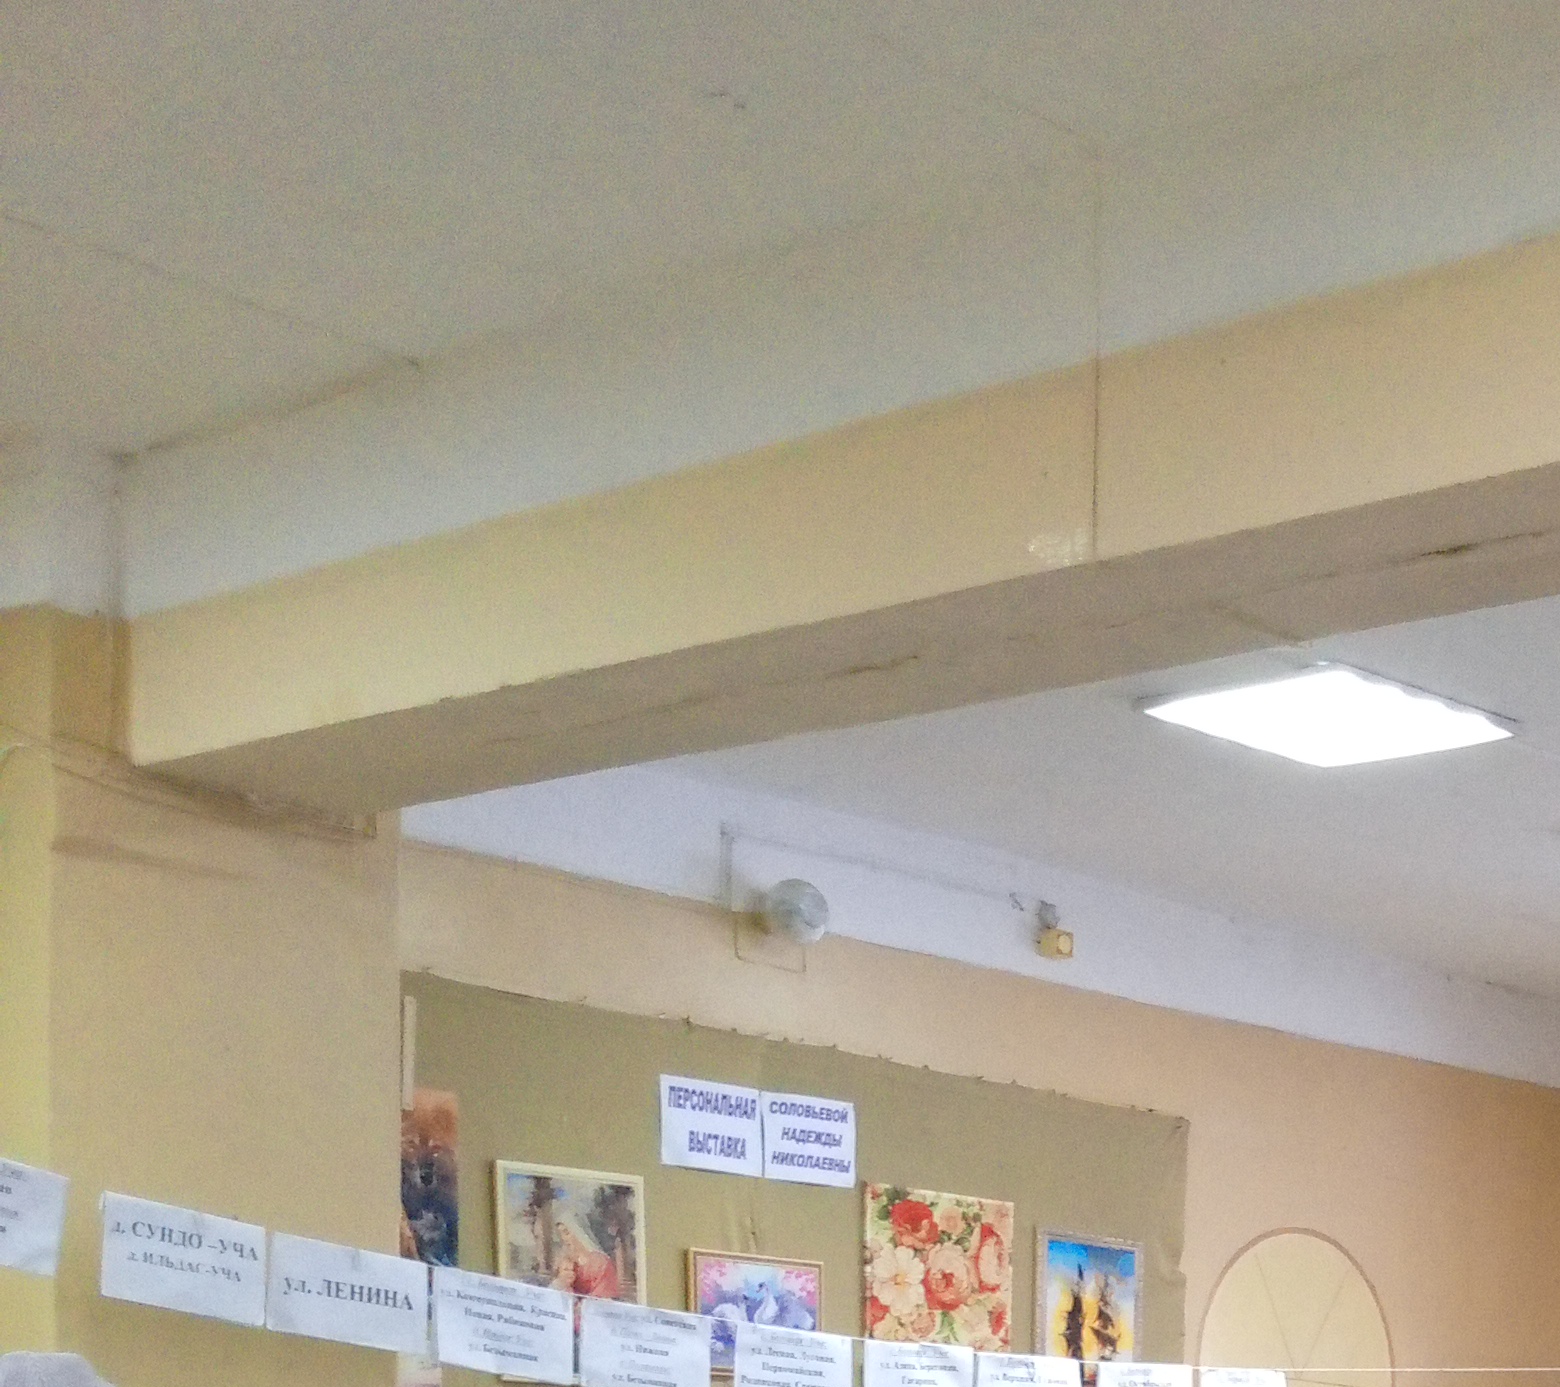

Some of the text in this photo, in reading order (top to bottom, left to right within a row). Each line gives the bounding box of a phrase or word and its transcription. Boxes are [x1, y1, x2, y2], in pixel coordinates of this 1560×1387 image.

[667, 1085, 757, 1121] ПЕРСОНАЛЬНАЯ
[769, 1101, 849, 1124] СОЛОВЬЕВОЙ
[688, 1129, 747, 1160] ВЫСТАВКА
[781, 1126, 843, 1149] НАДЕЖДЫ
[771, 1150, 851, 1174] НИКОЛАЕВНЫ
[131, 1220, 203, 1250] СУНДО
[282, 1276, 414, 1311] ул. ЛЕНИНА
